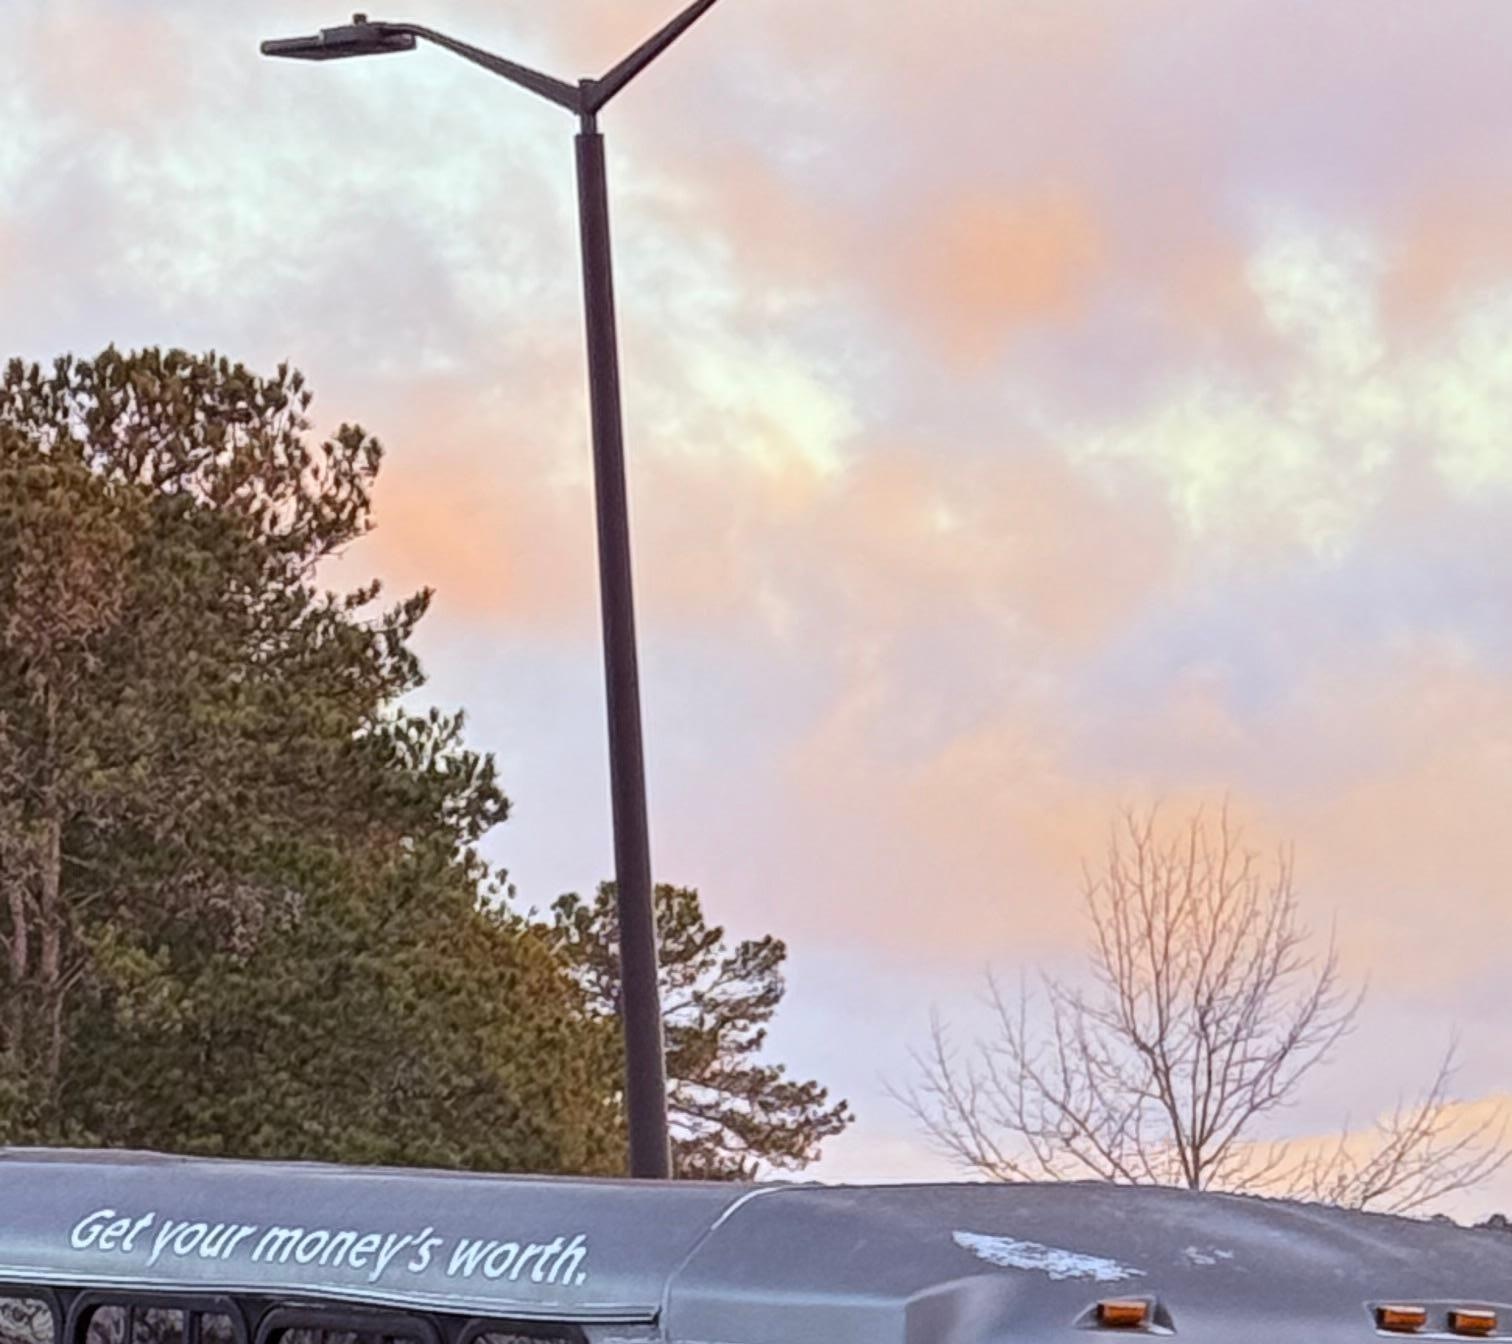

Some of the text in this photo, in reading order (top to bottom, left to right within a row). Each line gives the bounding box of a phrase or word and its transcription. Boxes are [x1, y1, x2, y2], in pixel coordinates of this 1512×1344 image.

[71, 1208, 588, 1285] Get your money's worth.
